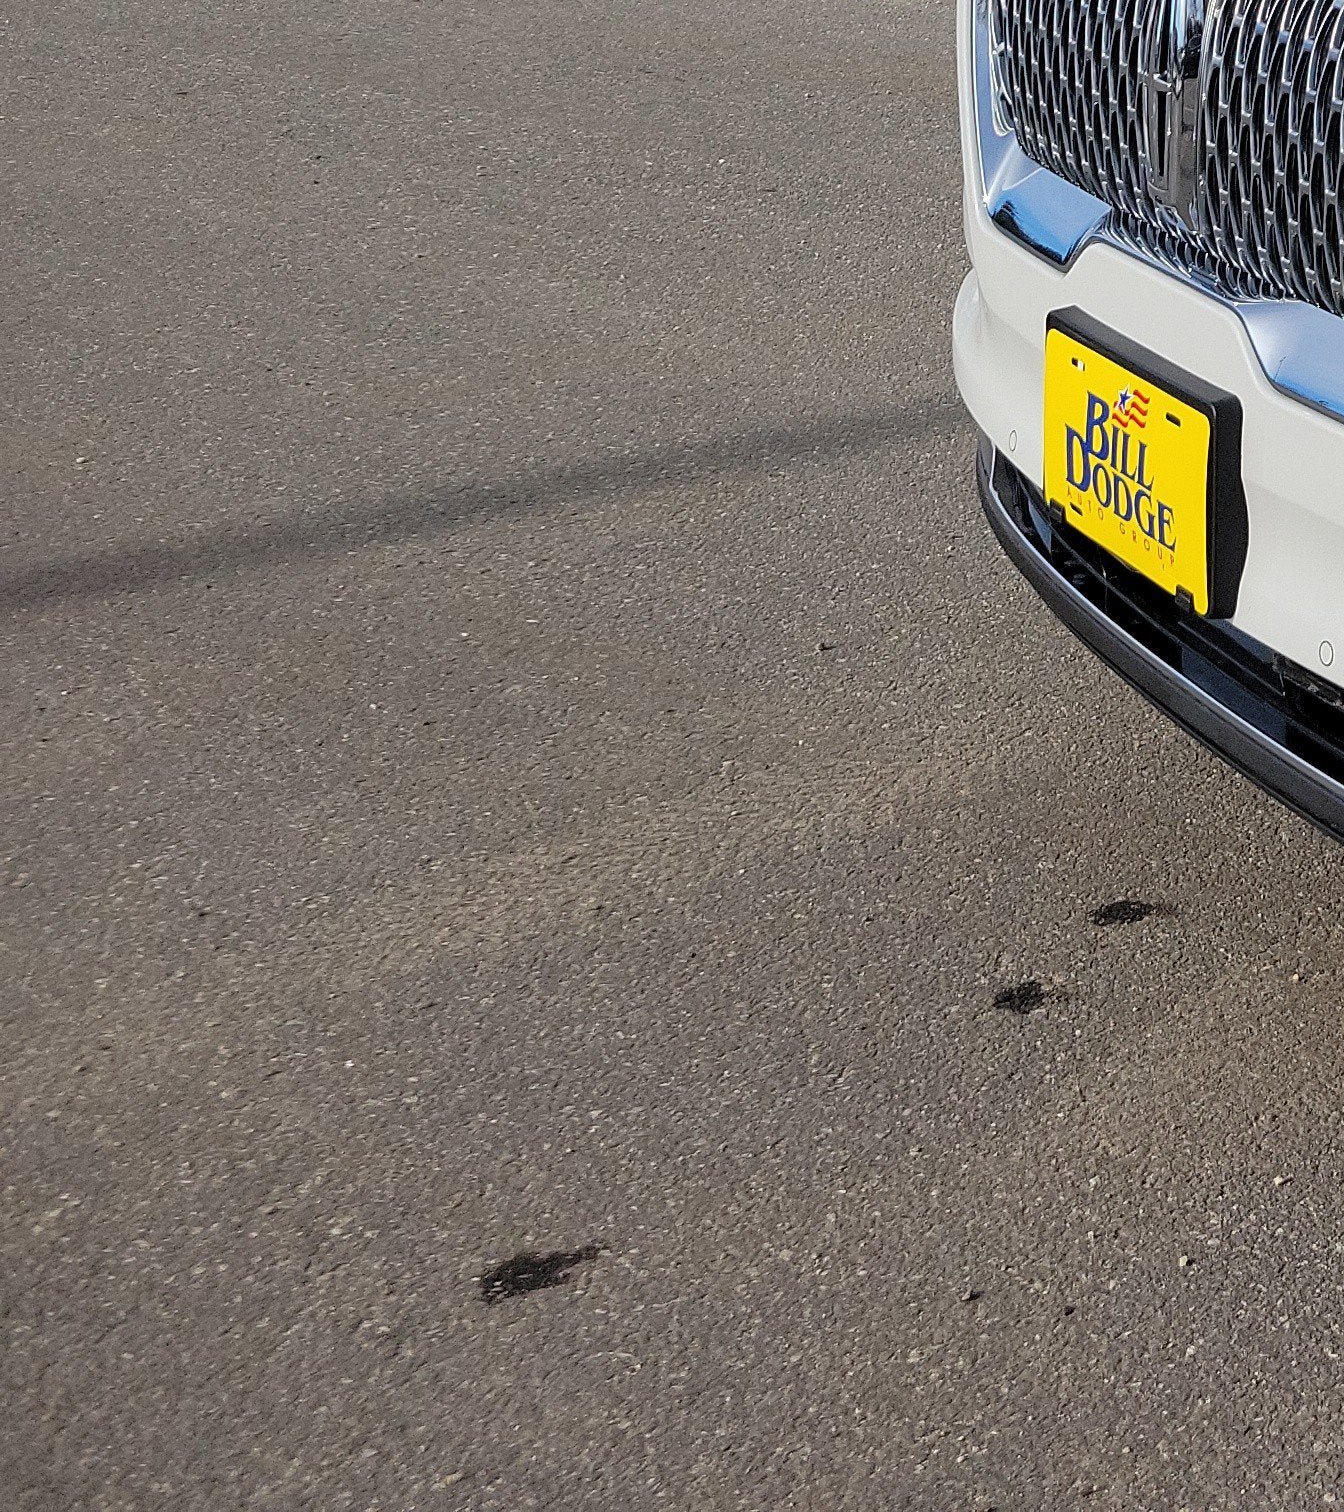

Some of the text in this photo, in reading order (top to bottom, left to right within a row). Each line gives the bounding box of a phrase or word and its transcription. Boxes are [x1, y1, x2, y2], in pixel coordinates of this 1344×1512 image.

[1065, 423, 1177, 553] DODGE
[1086, 390, 1154, 492] BILL
[1066, 484, 1175, 568] AUTO GROUP
